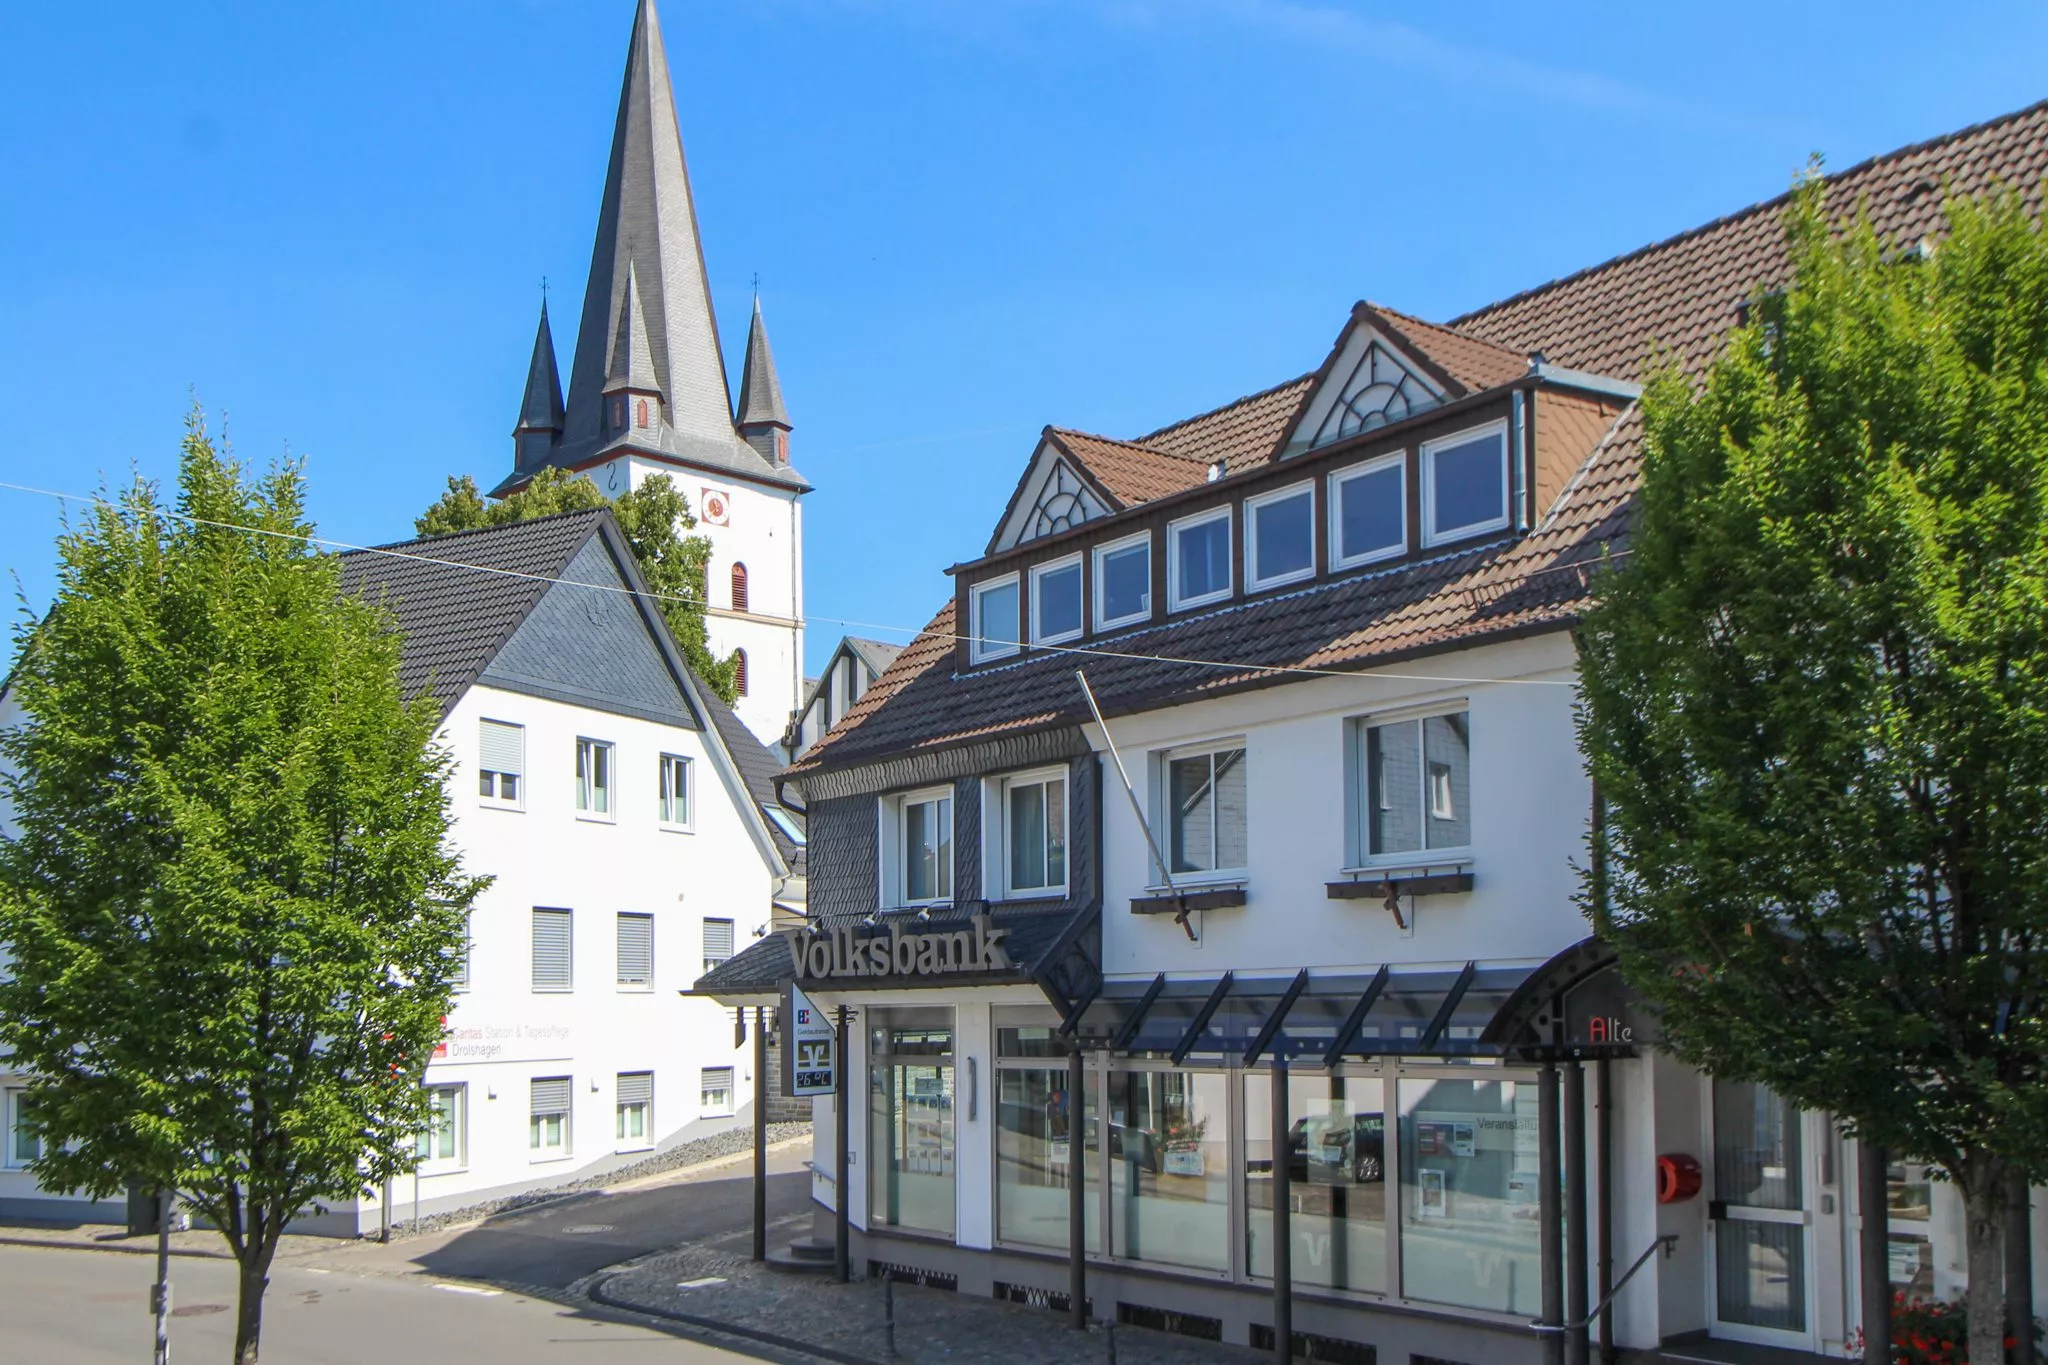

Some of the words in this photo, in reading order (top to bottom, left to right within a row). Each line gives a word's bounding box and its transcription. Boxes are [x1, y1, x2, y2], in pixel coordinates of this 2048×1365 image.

[784, 915, 1011, 980] Volksbank
[1590, 1016, 1632, 1042] Alte
[452, 1043, 501, 1058] Drolshagen
[1477, 1117, 1538, 1130] Veranstaltu
